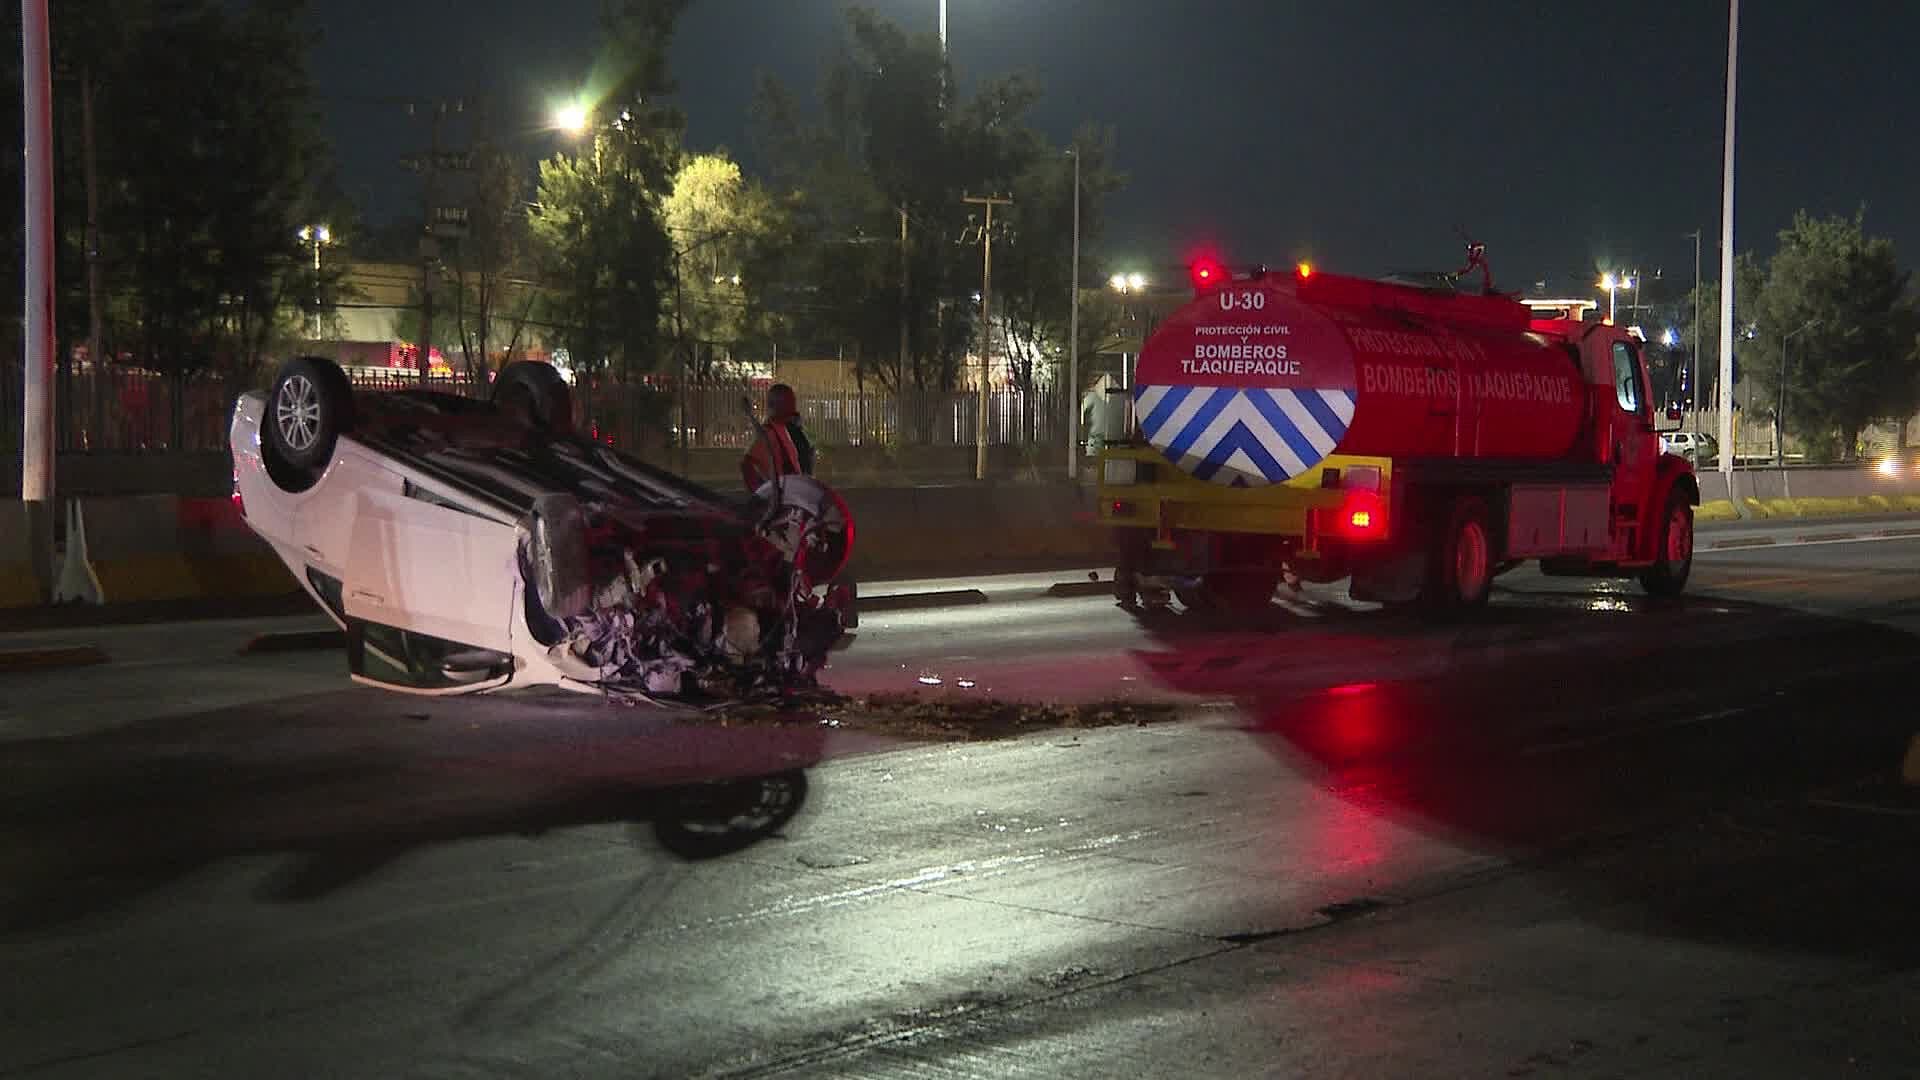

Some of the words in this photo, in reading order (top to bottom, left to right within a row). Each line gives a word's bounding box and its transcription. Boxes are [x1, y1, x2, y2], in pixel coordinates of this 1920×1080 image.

[1220, 292, 1265, 310] U-30
[1195, 325, 1261, 335] PROTECCIÓN
[1263, 326, 1290, 335] CIVIL
[1240, 335, 1248, 344] Y
[1195, 345, 1287, 359] BOMBEROS
[1181, 360, 1301, 375] TLAQUEPAQUE
[1363, 364, 1458, 399] BOMBEROS
